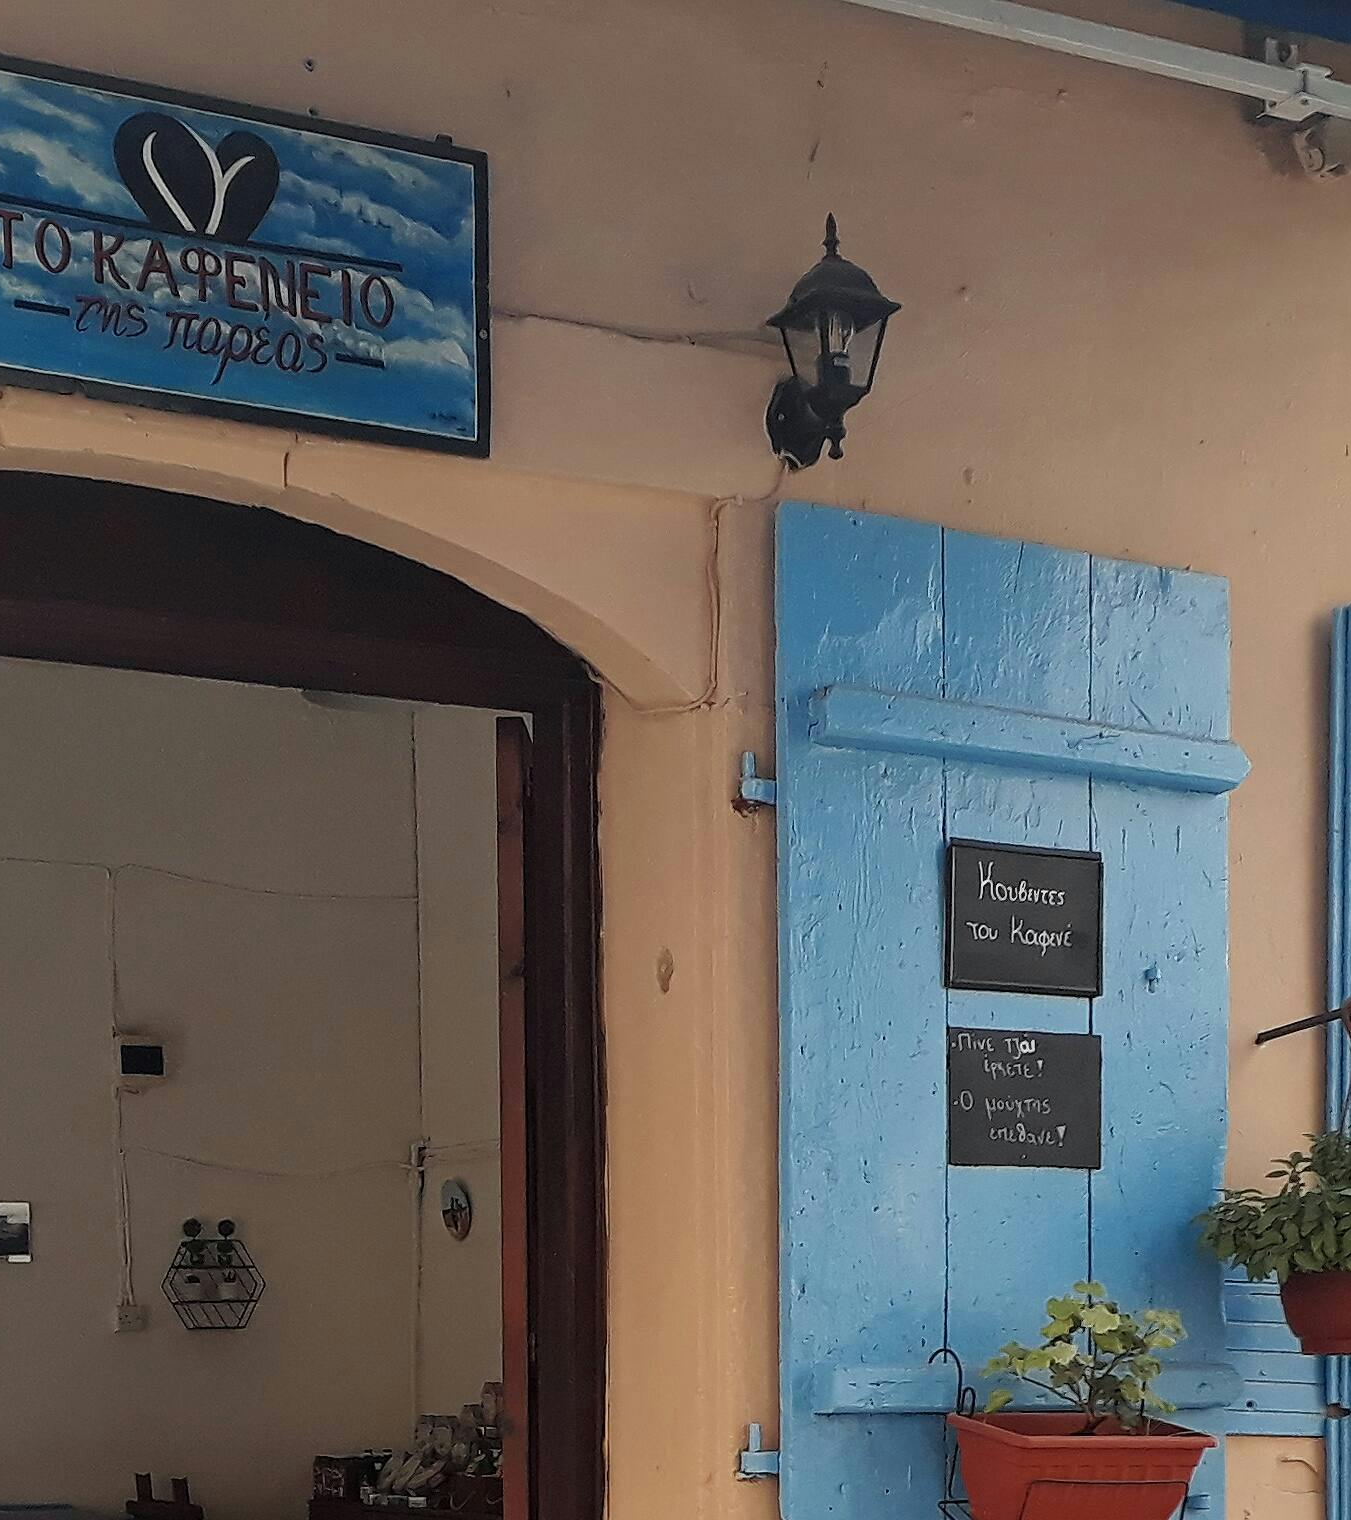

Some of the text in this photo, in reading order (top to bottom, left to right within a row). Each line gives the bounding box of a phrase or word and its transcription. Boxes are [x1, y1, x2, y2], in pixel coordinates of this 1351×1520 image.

[92, 229, 396, 330] ΚΑΦΕΝΕΙΟ
[74, 294, 148, 338] της
[966, 921, 998, 941] του
